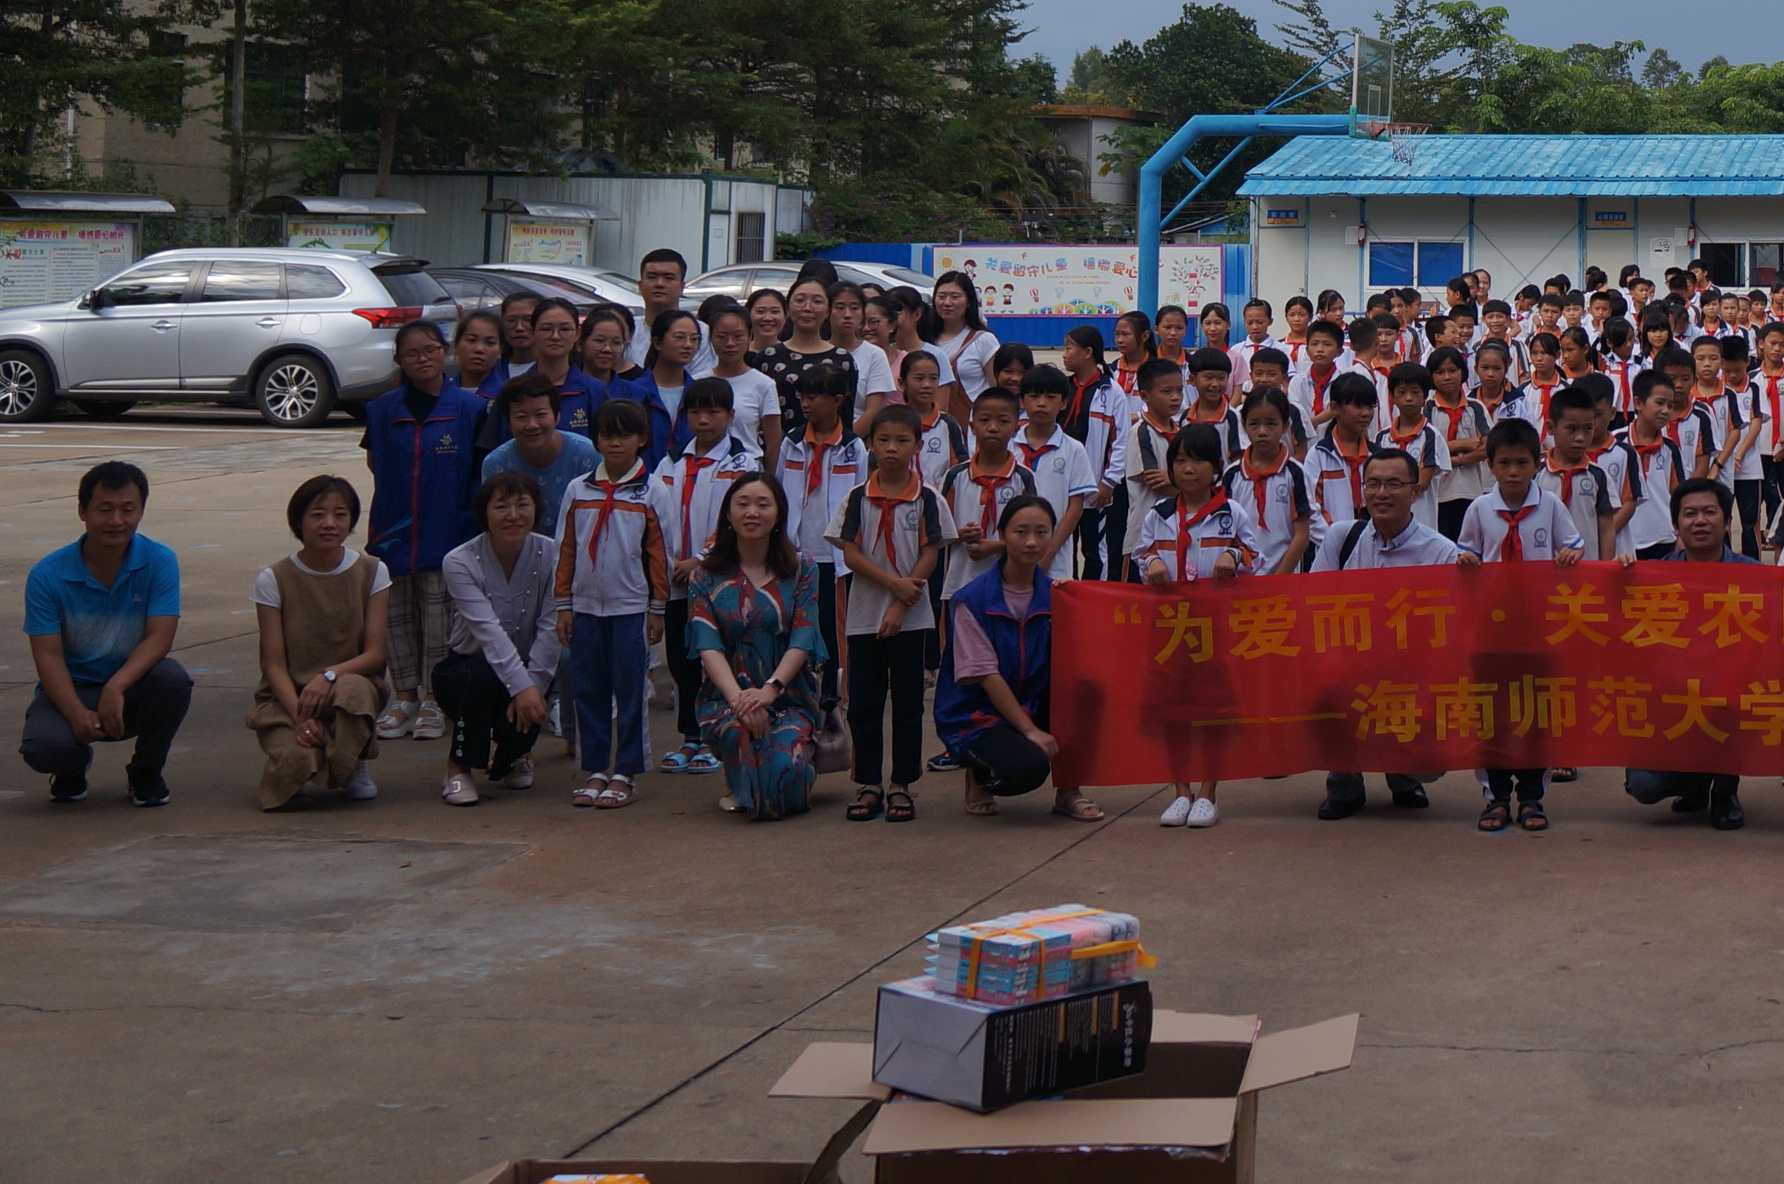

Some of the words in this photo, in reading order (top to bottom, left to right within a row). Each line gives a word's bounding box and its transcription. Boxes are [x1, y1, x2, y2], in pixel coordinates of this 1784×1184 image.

[985, 256, 1068, 278] 关爱留守儿童
